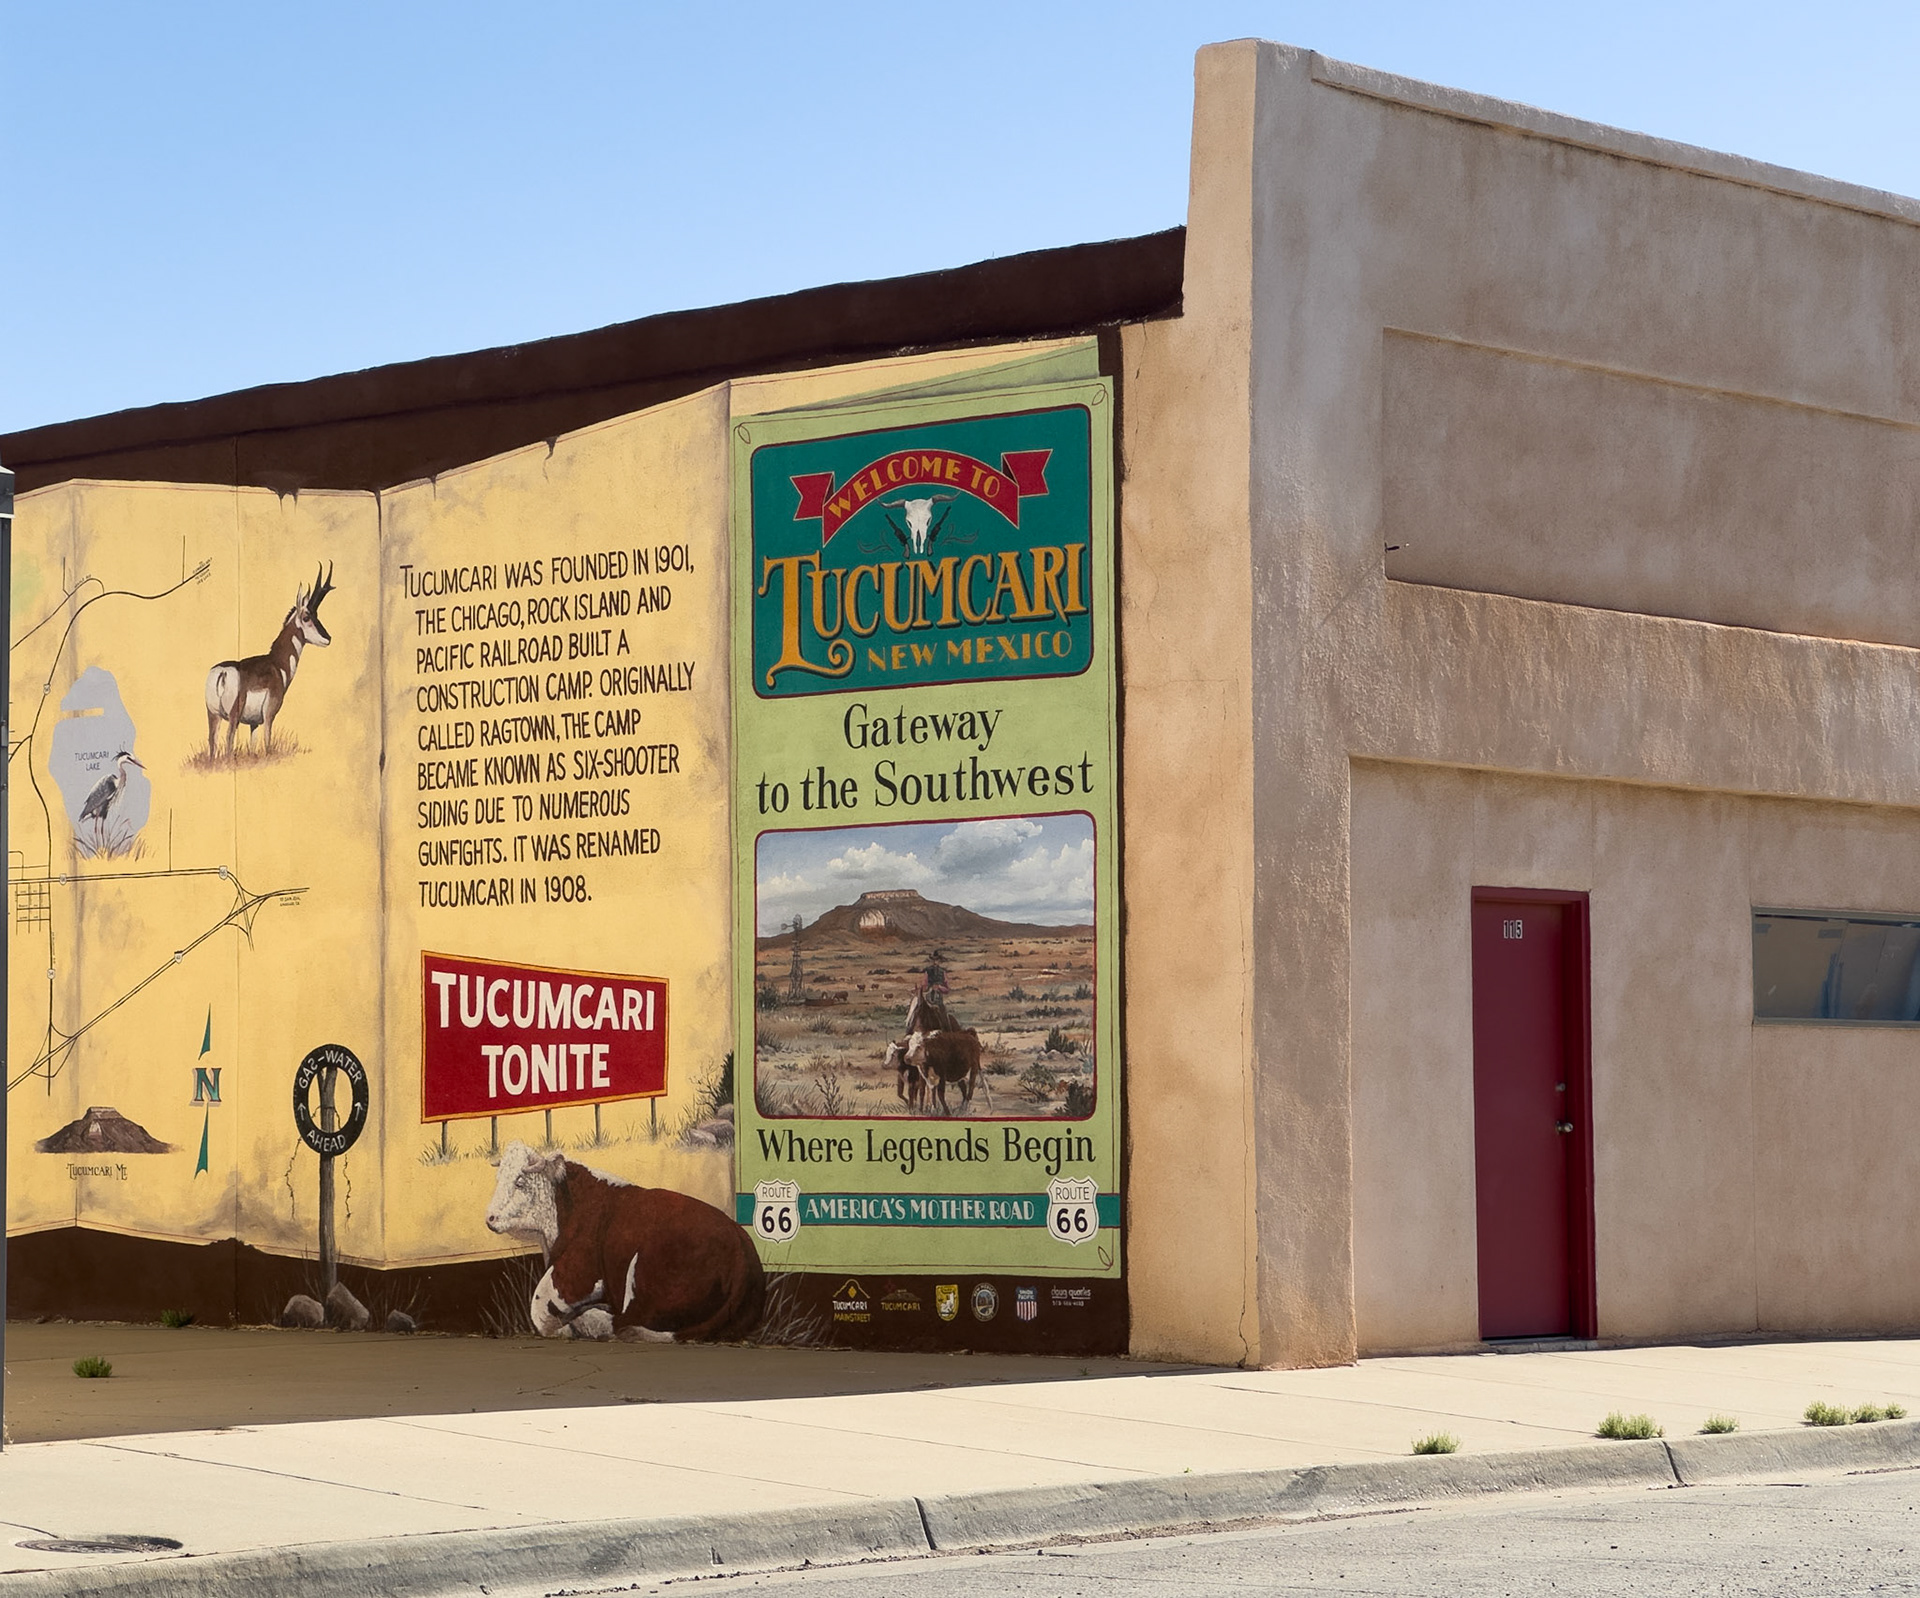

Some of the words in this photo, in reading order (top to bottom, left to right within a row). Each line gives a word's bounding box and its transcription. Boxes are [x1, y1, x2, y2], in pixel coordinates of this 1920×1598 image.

[828, 455, 963, 519] WELCOME
[971, 464, 1001, 498] TO
[400, 564, 497, 599] TUCUMCARI
[504, 560, 543, 589] WAS
[551, 550, 628, 585] FOUNDED
[633, 548, 650, 576] IN
[655, 544, 695, 574] 1901,
[415, 607, 447, 636] THE
[528, 595, 571, 625] ROCK
[574, 590, 631, 620] ISLAND
[637, 585, 672, 615] AND
[758, 543, 1088, 689] TUCUMCARI
[416, 643, 475, 674] PACIFIC
[480, 635, 563, 668] RAILROAD
[569, 629, 612, 660] BUILT
[616, 629, 630, 655] A
[867, 642, 938, 672] NEW
[946, 630, 1072, 665] MEXICO
[416, 675, 540, 712] CONSTRUCTION
[546, 670, 593, 701] CAMP.
[600, 661, 695, 697] ORIGINALLY
[418, 721, 475, 751] CALLED
[480, 714, 560, 747] RAGTOWN,
[561, 712, 590, 740] THE
[595, 708, 641, 738] CAMP
[843, 703, 1004, 751] Gateway
[75, 751, 110, 760] TUCUMCARI
[86, 763, 100, 771] LAKE
[417, 759, 479, 791] BECAME
[484, 753, 540, 787] KNOWN
[546, 752, 566, 782] AS
[573, 744, 680, 780] SIX-SHOOTER
[755, 771, 789, 815] to
[800, 766, 858, 811] the
[874, 751, 1095, 807] Southwest
[417, 799, 468, 829] SIDING
[475, 797, 506, 825] DUE
[512, 795, 533, 822] TO
[539, 789, 630, 821] NUMEROUS
[418, 838, 507, 867] GUNFIGHTS.
[513, 835, 528, 862] IT
[531, 834, 570, 862] WAS
[576, 828, 661, 860] RENAMED
[418, 878, 514, 907] TUCUMCARI
[520, 878, 537, 903] IN
[544, 875, 592, 903] 1908.
[1503, 920, 1522, 938] 115
[431, 971, 655, 1031] TUCUMCARI
[193, 1067, 222, 1103] N
[481, 1044, 611, 1098] TONITE
[306, 1130, 346, 1152] AHEAD
[756, 1128, 854, 1163] Where
[865, 1127, 989, 1175] Legends
[1002, 1127, 1096, 1176] Begin
[66, 1163, 113, 1180] TUCUMCARI
[762, 1186, 792, 1199] ROUTE
[805, 1197, 906, 1221] AMERICA'S
[910, 1199, 986, 1220] MOTHER
[989, 1199, 1035, 1221] ROAD
[1055, 1187, 1090, 1201] ROUTE
[761, 1205, 792, 1233] 66
[1056, 1208, 1088, 1234] 66
[832, 1301, 867, 1310] TUCUMCARI
[881, 1302, 921, 1311] TUCUMCARI
